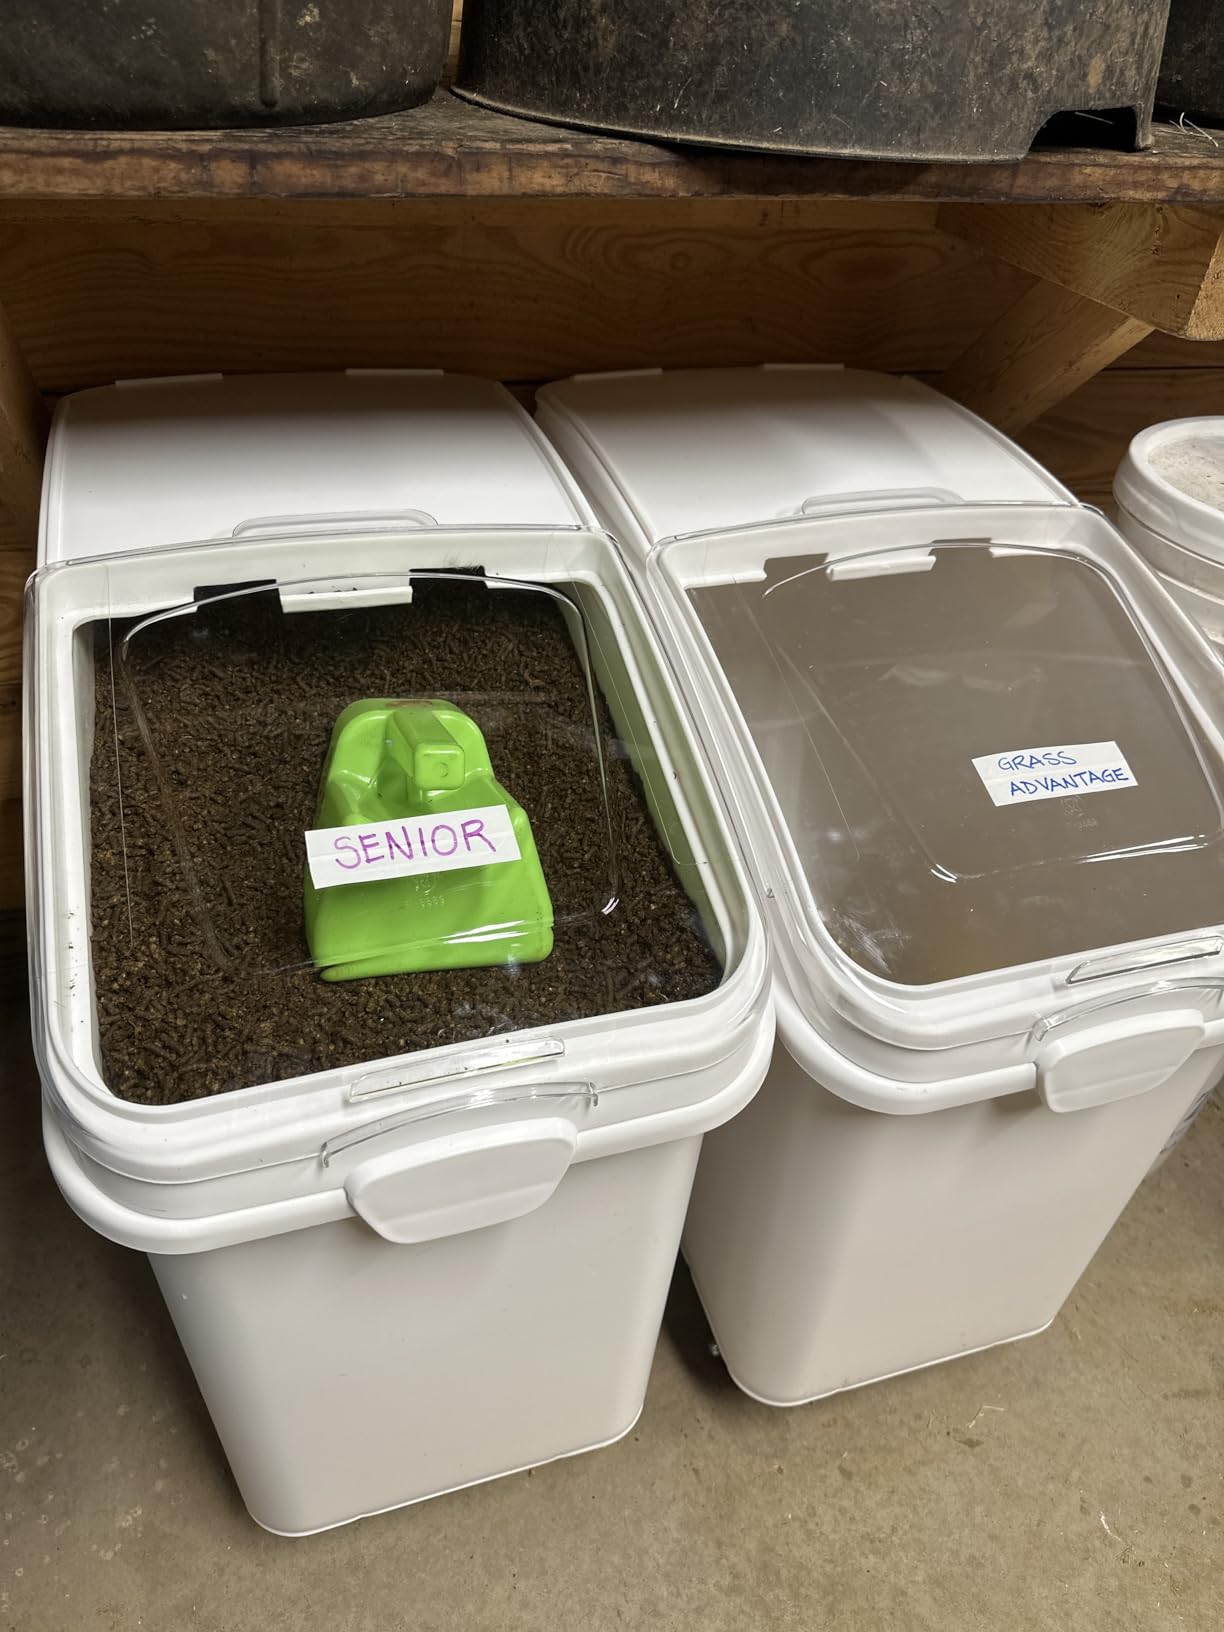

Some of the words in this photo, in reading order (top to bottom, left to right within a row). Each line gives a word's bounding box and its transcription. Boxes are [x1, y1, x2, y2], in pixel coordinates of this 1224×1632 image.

[998, 751, 1077, 771] GRASS
[1010, 768, 1129, 796] ADVANTAGE
[334, 819, 496, 869] SENIOR
